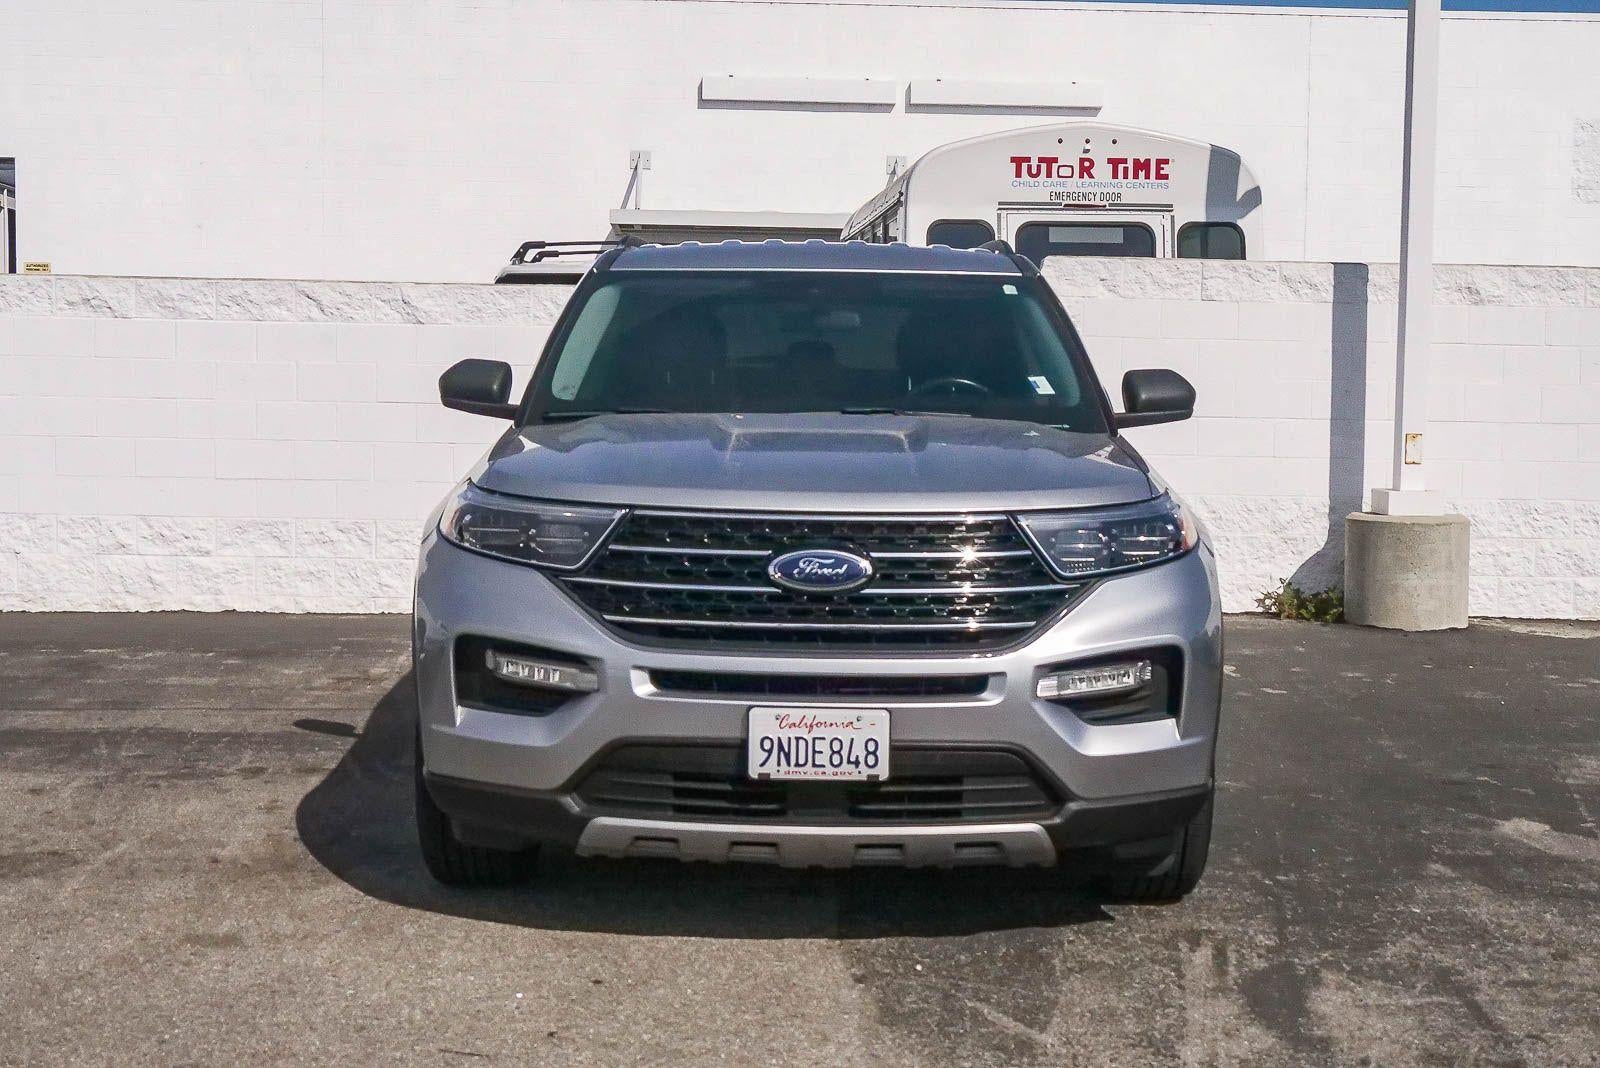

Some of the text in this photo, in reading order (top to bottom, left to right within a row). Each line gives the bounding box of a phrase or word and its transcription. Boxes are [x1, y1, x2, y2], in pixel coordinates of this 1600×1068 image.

[1011, 180, 1169, 190] CHILD CARE LEARNING CENTERS
[1049, 191, 1122, 202] EMERGENCY DOOR
[793, 557, 848, 577] Ford
[778, 713, 862, 735] California
[758, 735, 880, 769] 9NDE848
